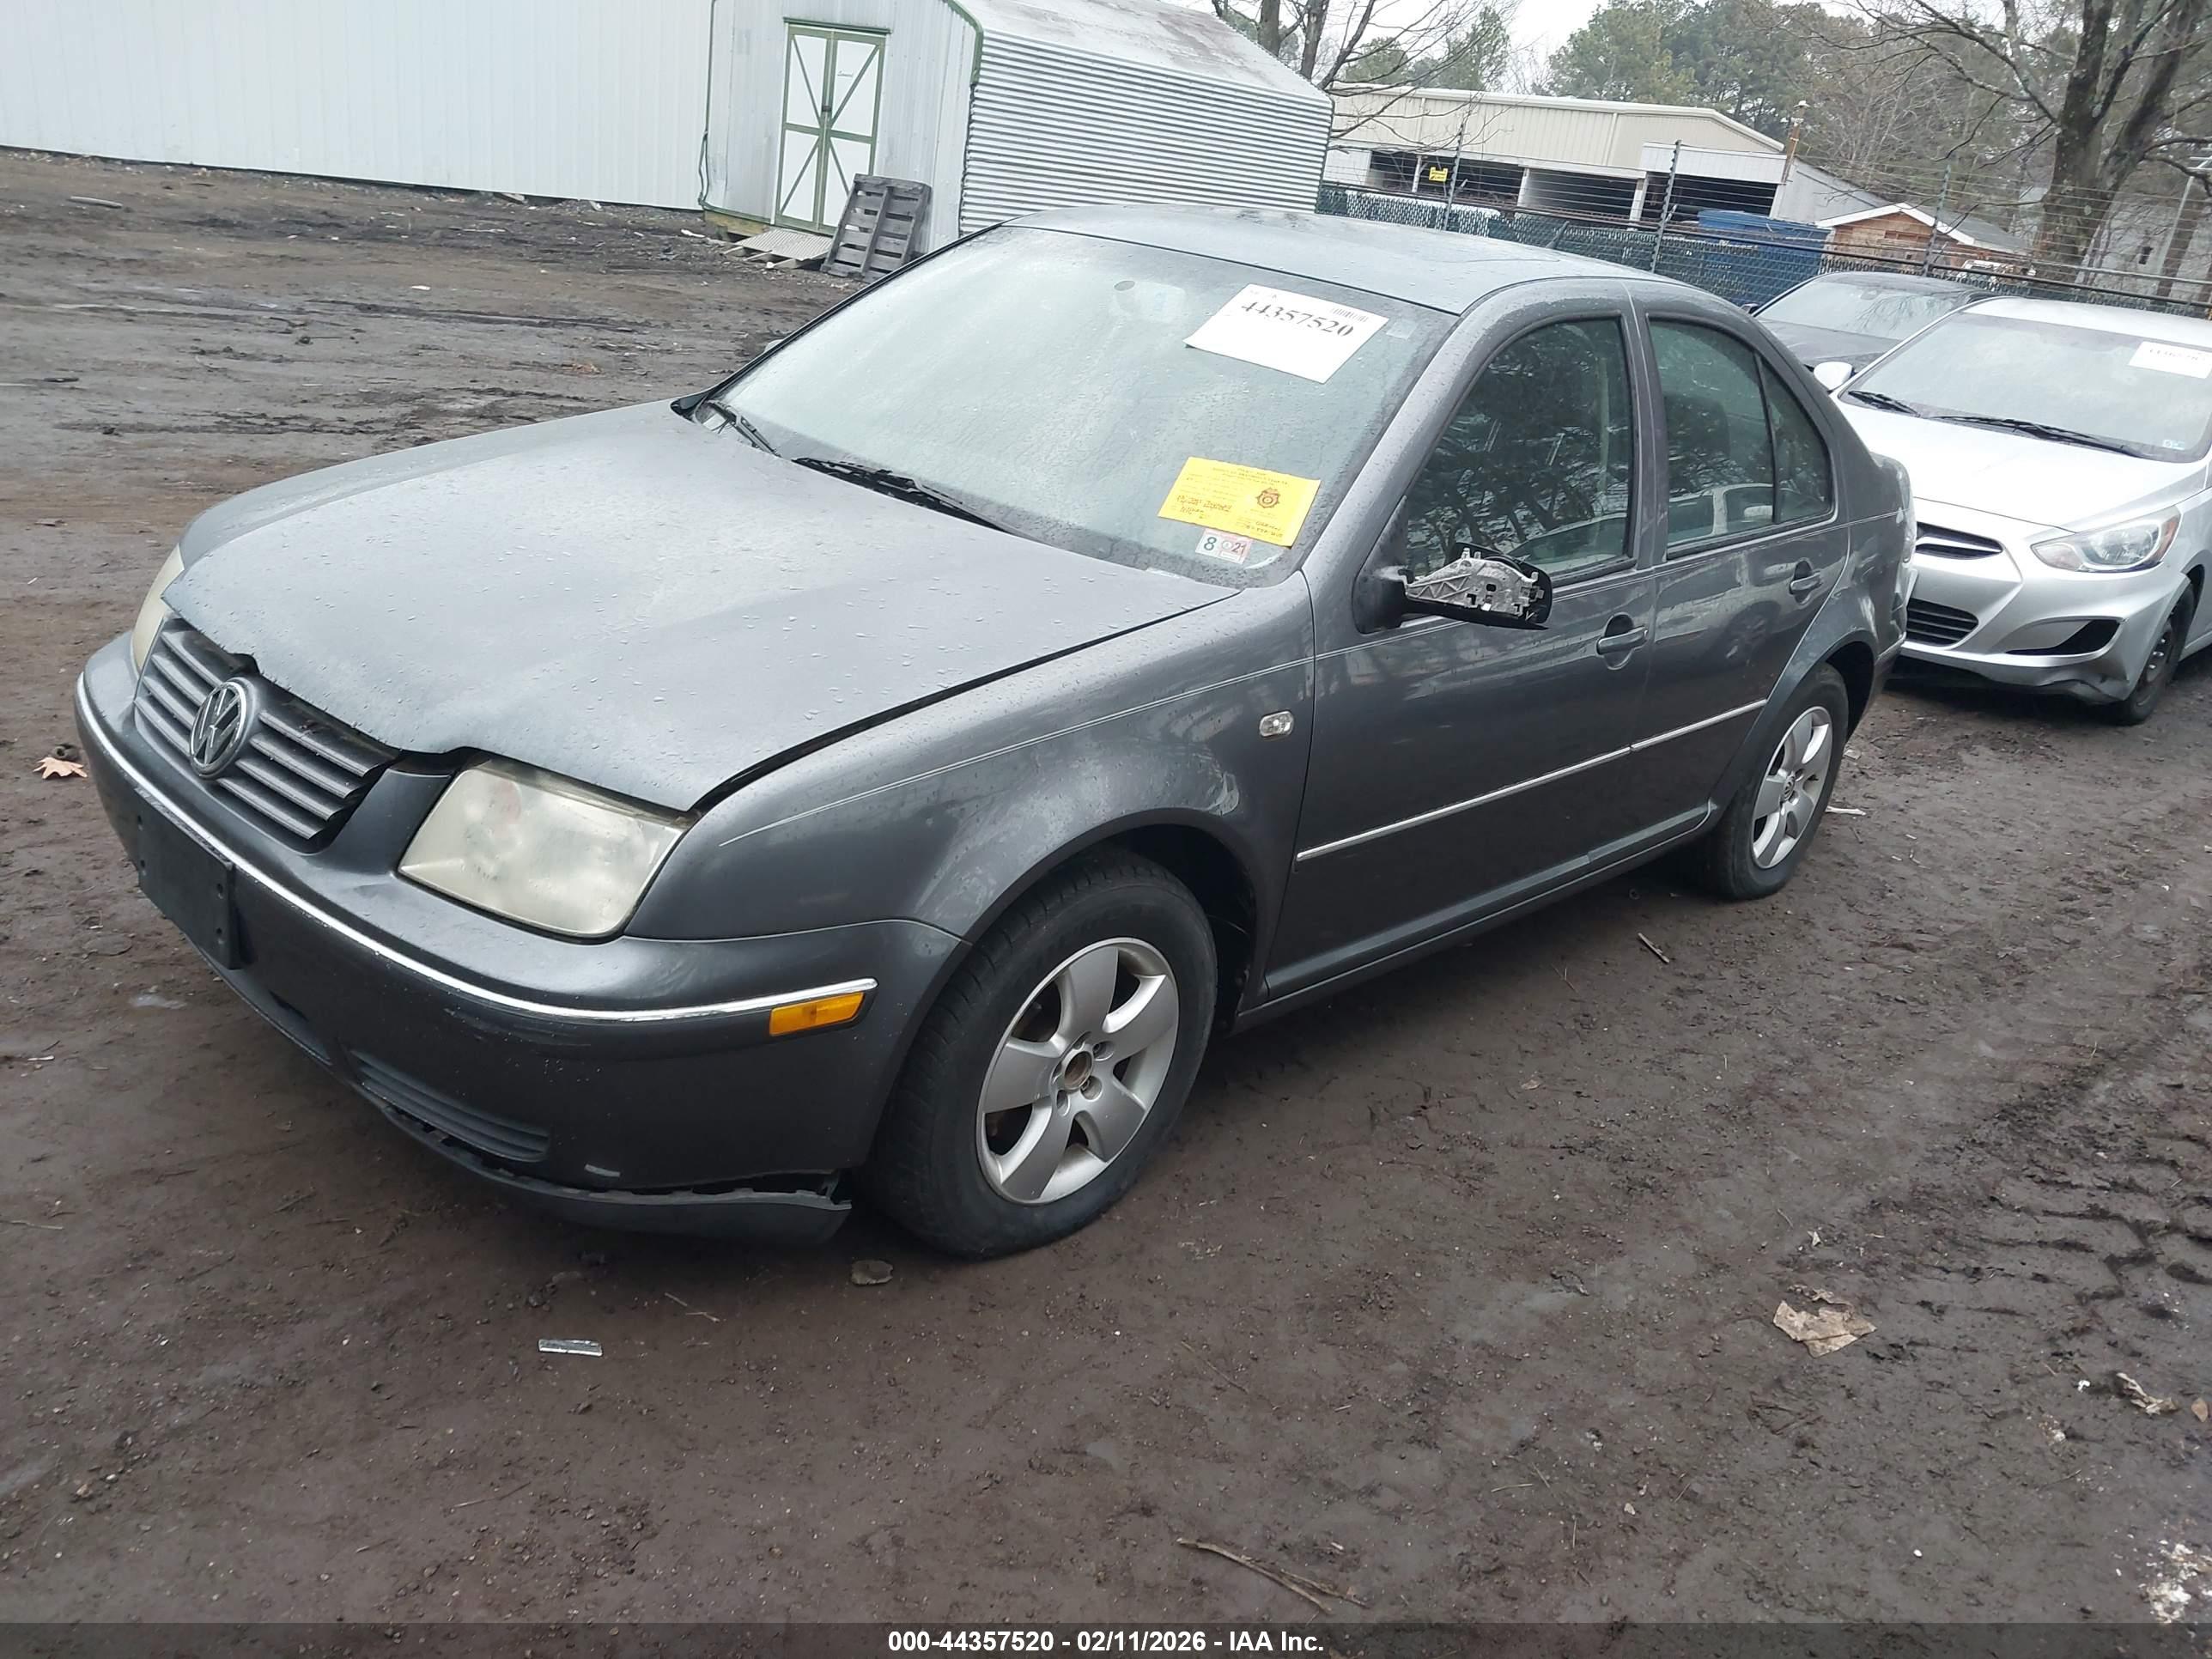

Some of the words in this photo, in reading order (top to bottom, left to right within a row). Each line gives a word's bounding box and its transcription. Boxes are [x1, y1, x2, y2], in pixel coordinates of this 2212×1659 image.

[1241, 301, 1354, 337] 44357520
[1203, 536, 1218, 551] 8
[1231, 542, 1248, 555] 21
